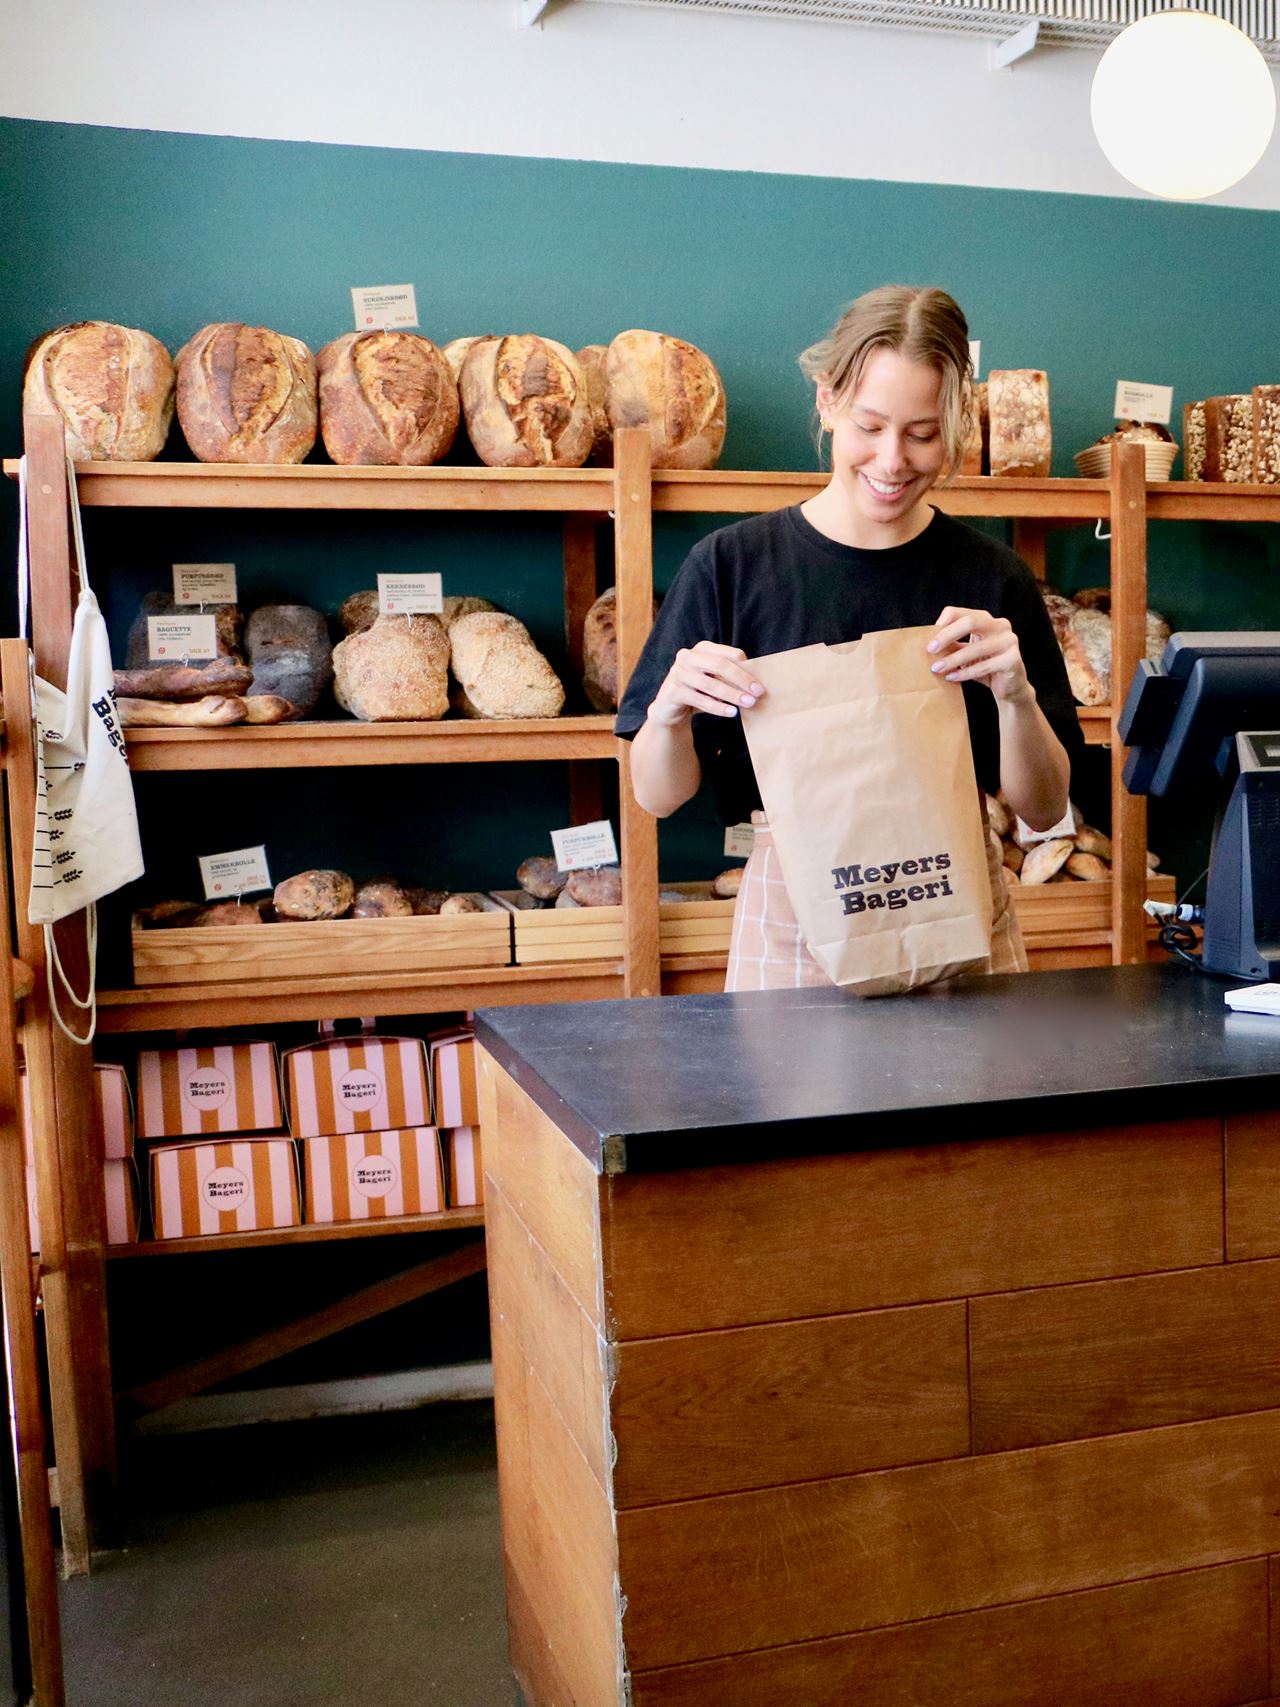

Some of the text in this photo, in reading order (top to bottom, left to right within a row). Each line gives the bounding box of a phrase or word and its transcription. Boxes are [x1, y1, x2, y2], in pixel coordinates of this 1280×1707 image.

[831, 853, 951, 890] Meyers
[840, 875, 953, 915] Bageri
[191, 1088, 225, 1096] Bageri
[344, 1089, 376, 1098] Bageri
[210, 1188, 243, 1196] Bageri
